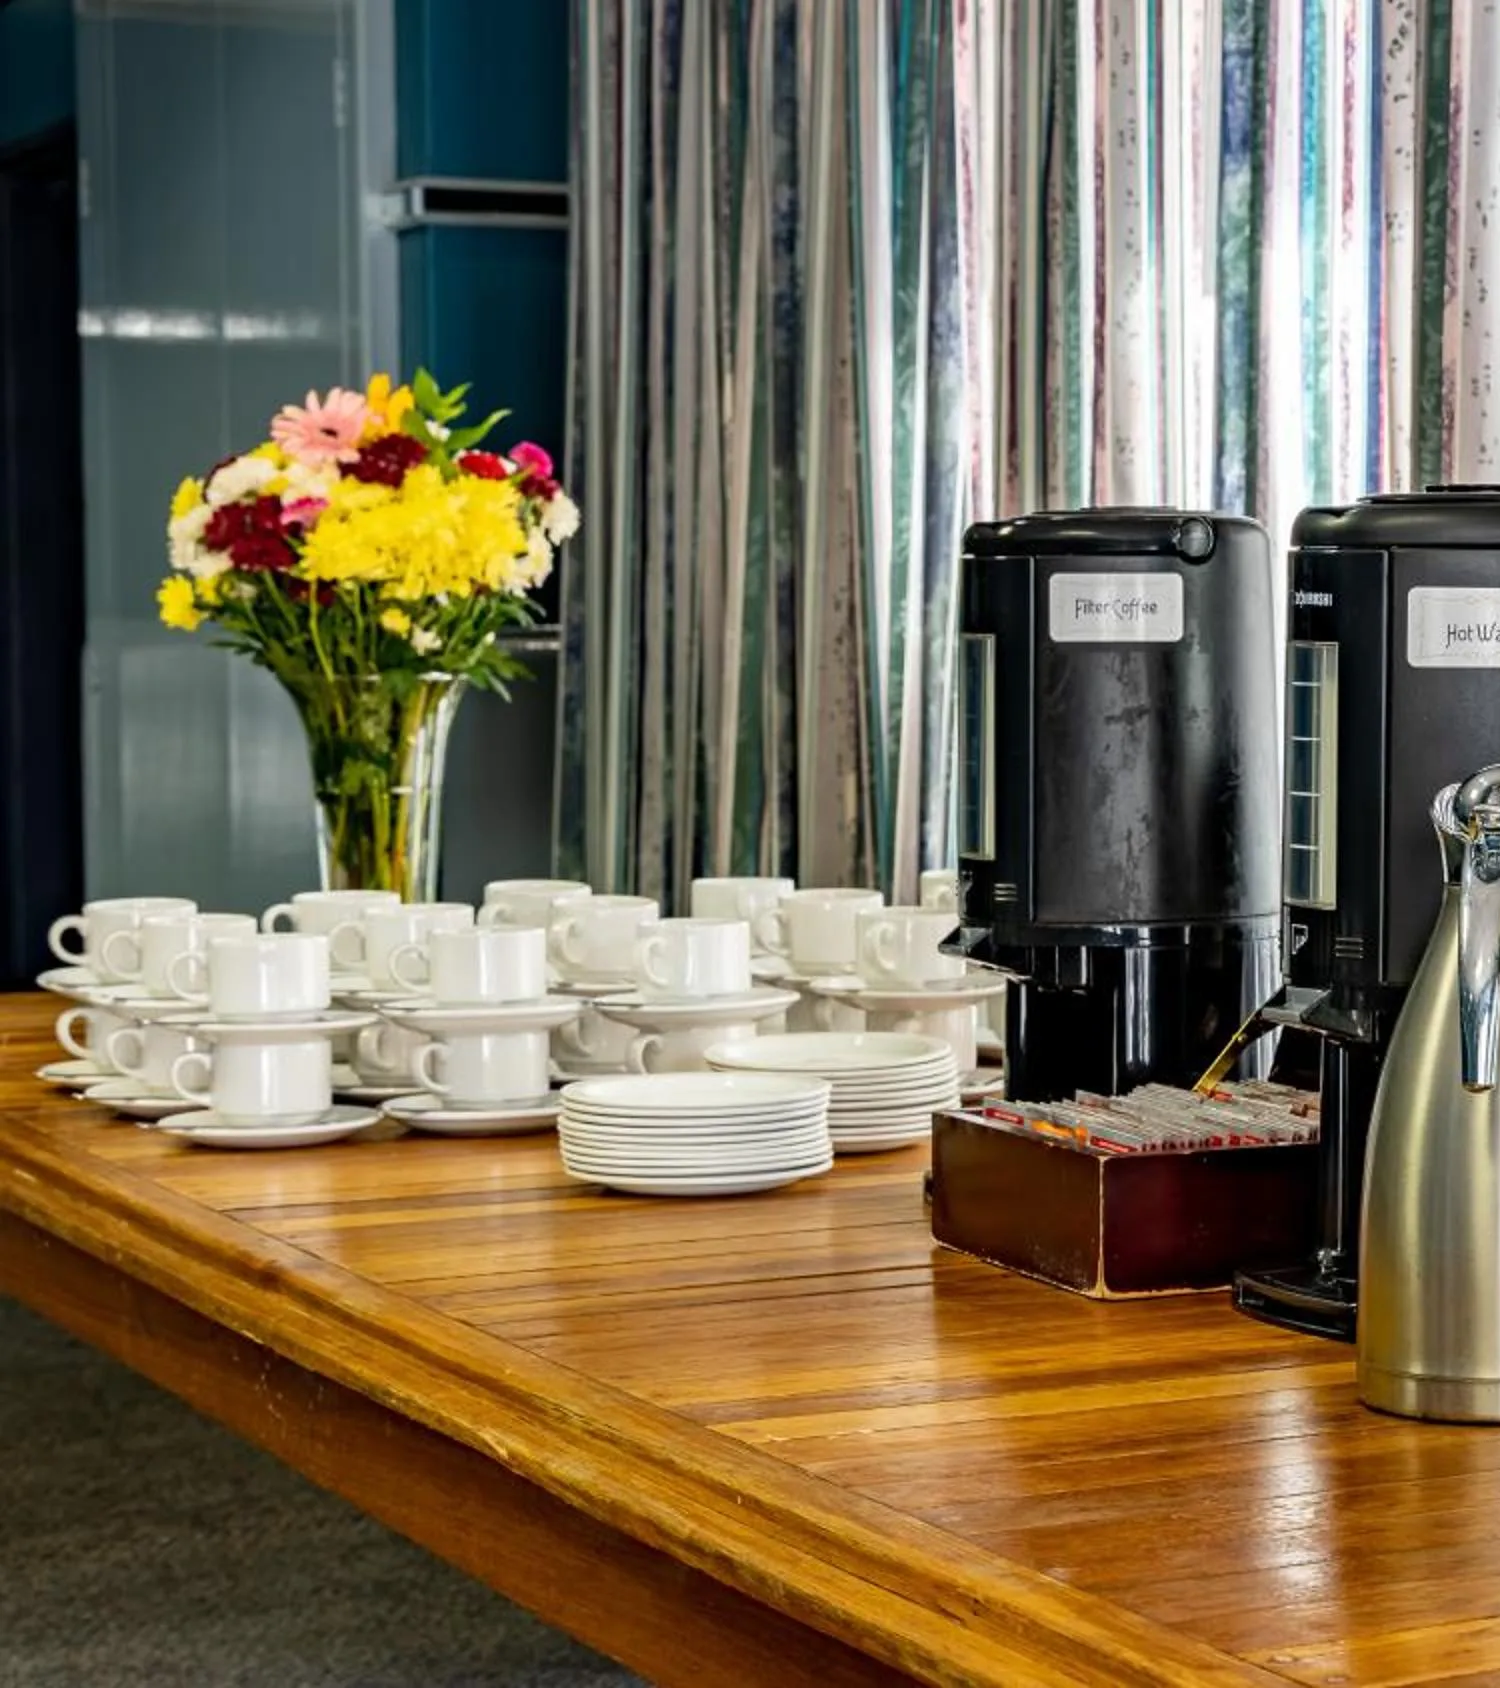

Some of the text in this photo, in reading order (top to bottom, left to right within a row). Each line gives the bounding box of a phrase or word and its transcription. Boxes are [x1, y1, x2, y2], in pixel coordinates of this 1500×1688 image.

[1075, 598, 1158, 620] Filter Coffee
[1445, 623, 1473, 649] Hot
